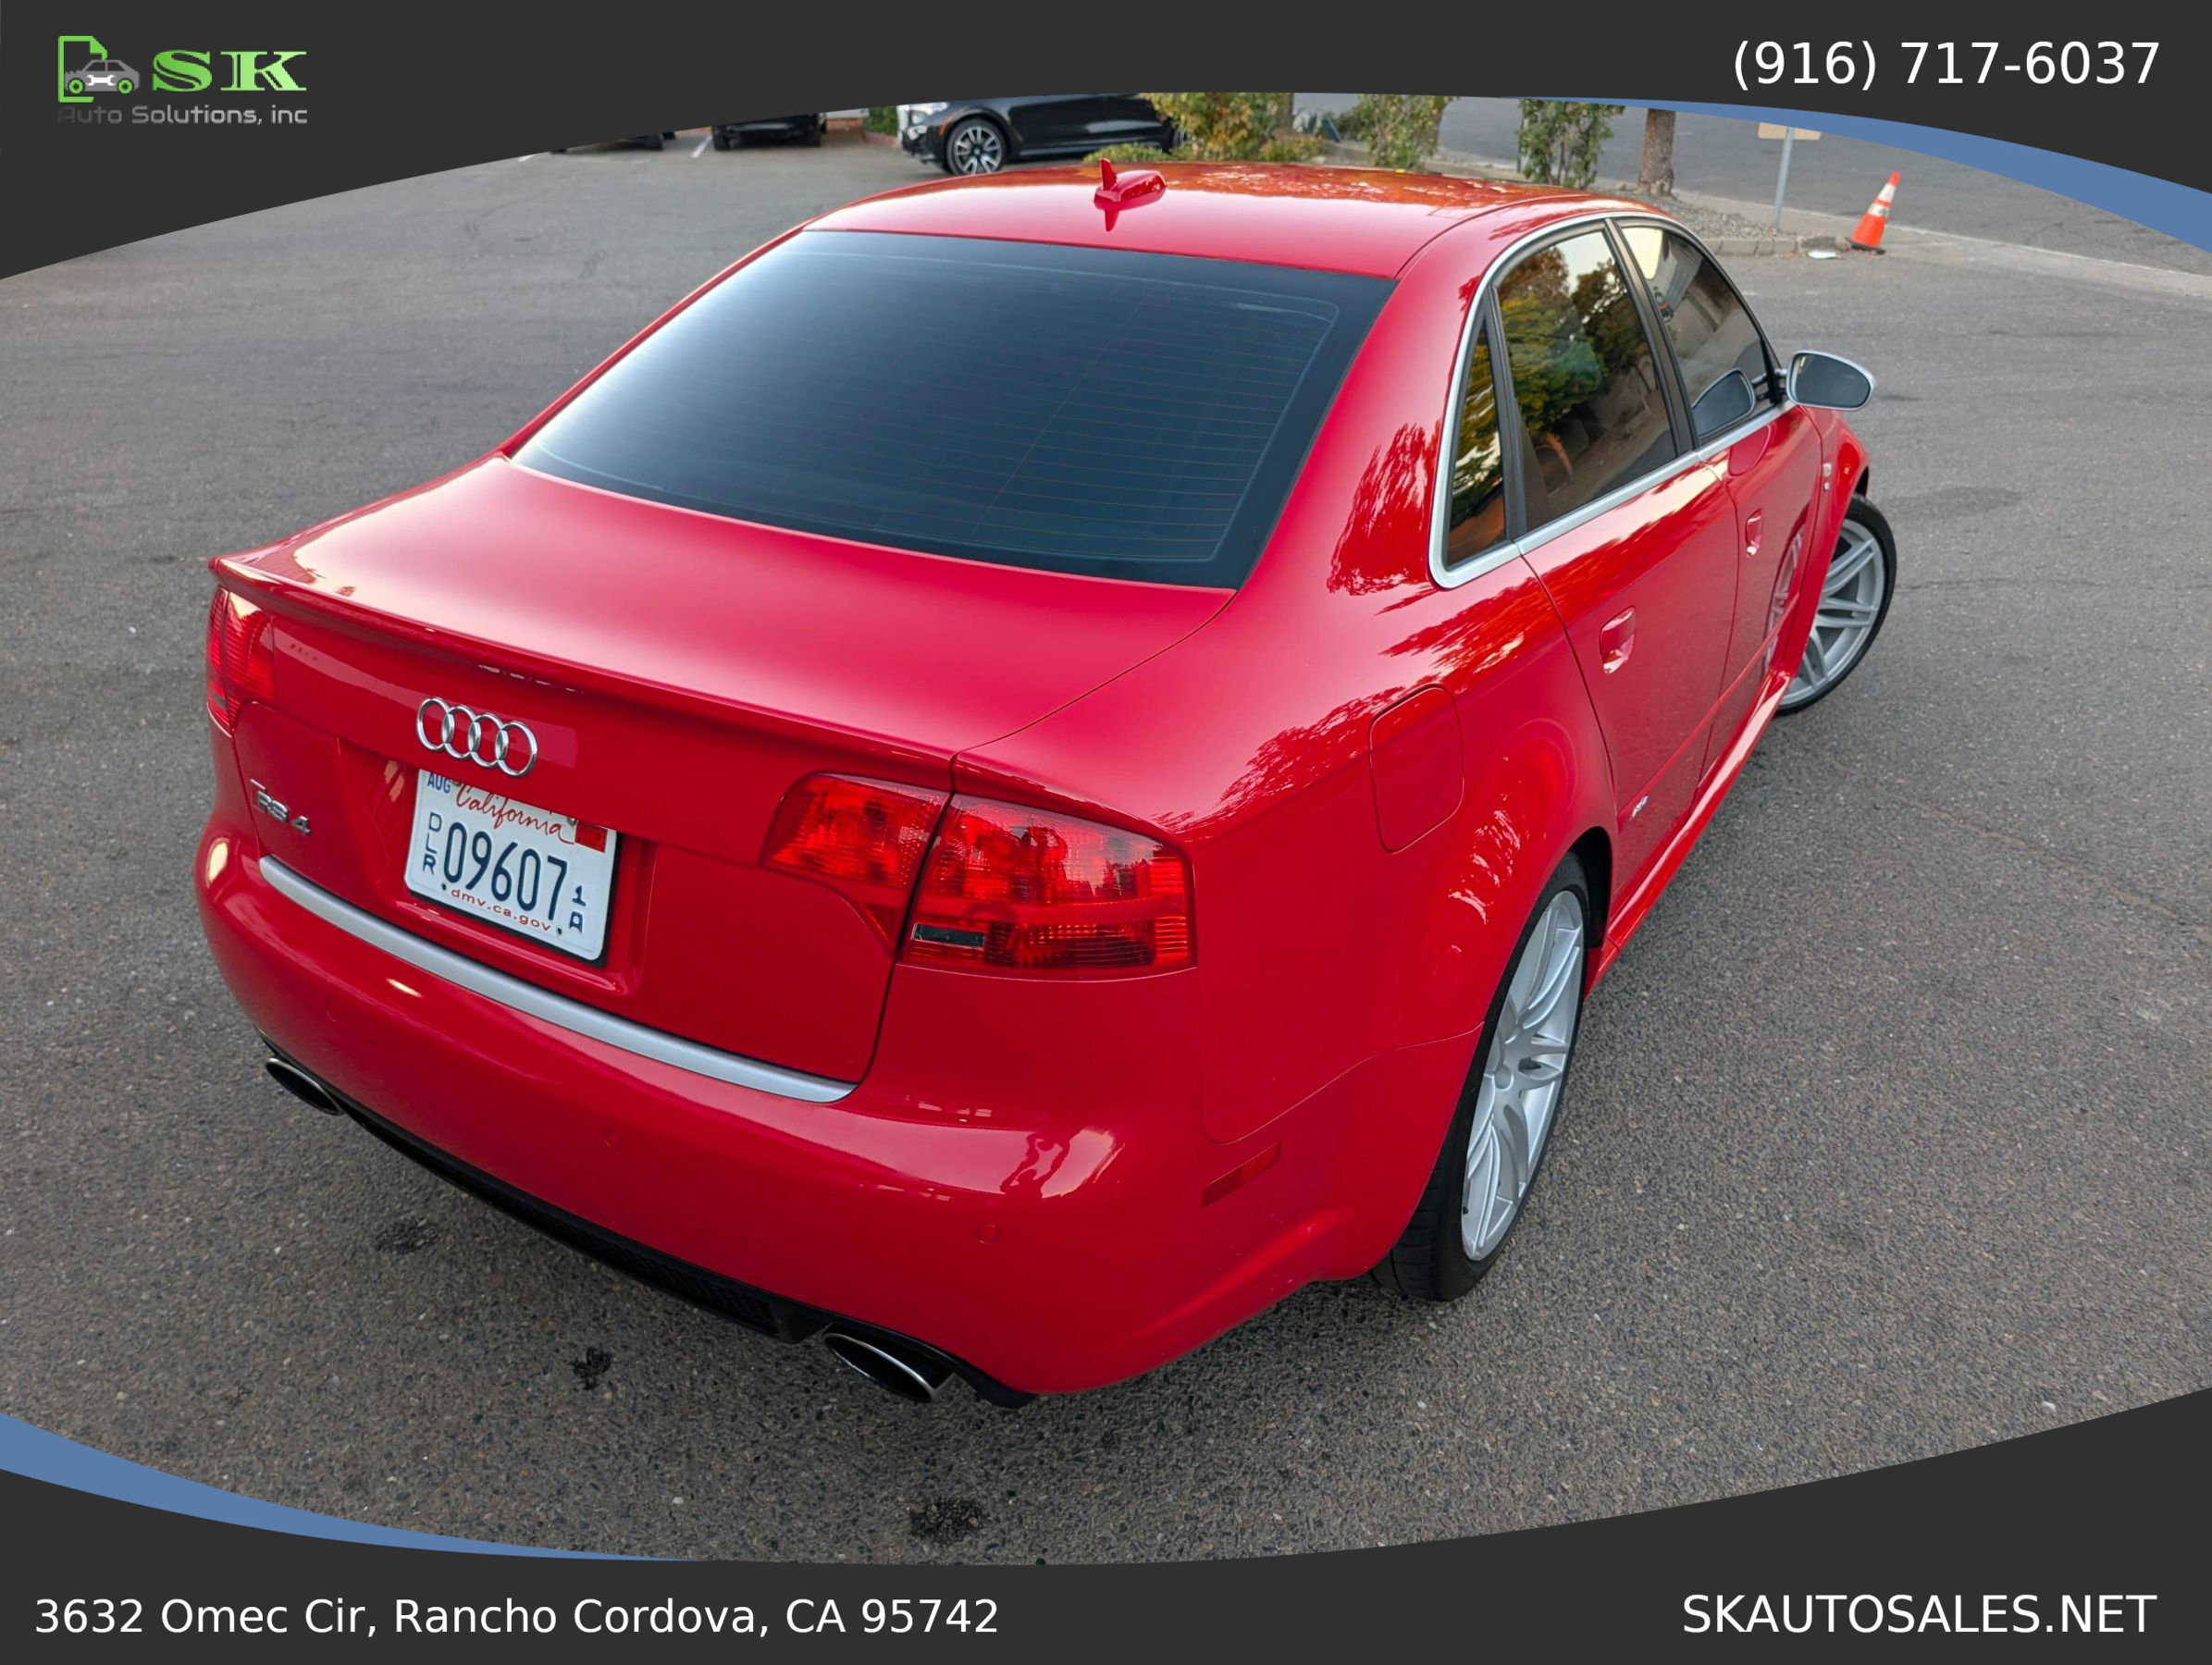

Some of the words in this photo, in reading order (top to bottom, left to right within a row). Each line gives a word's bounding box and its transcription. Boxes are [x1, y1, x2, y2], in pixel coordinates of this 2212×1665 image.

[426, 771, 451, 794] AUG
[456, 783, 575, 845] California
[443, 821, 568, 921] 09607
[451, 889, 551, 931] dmv.ca.gov
